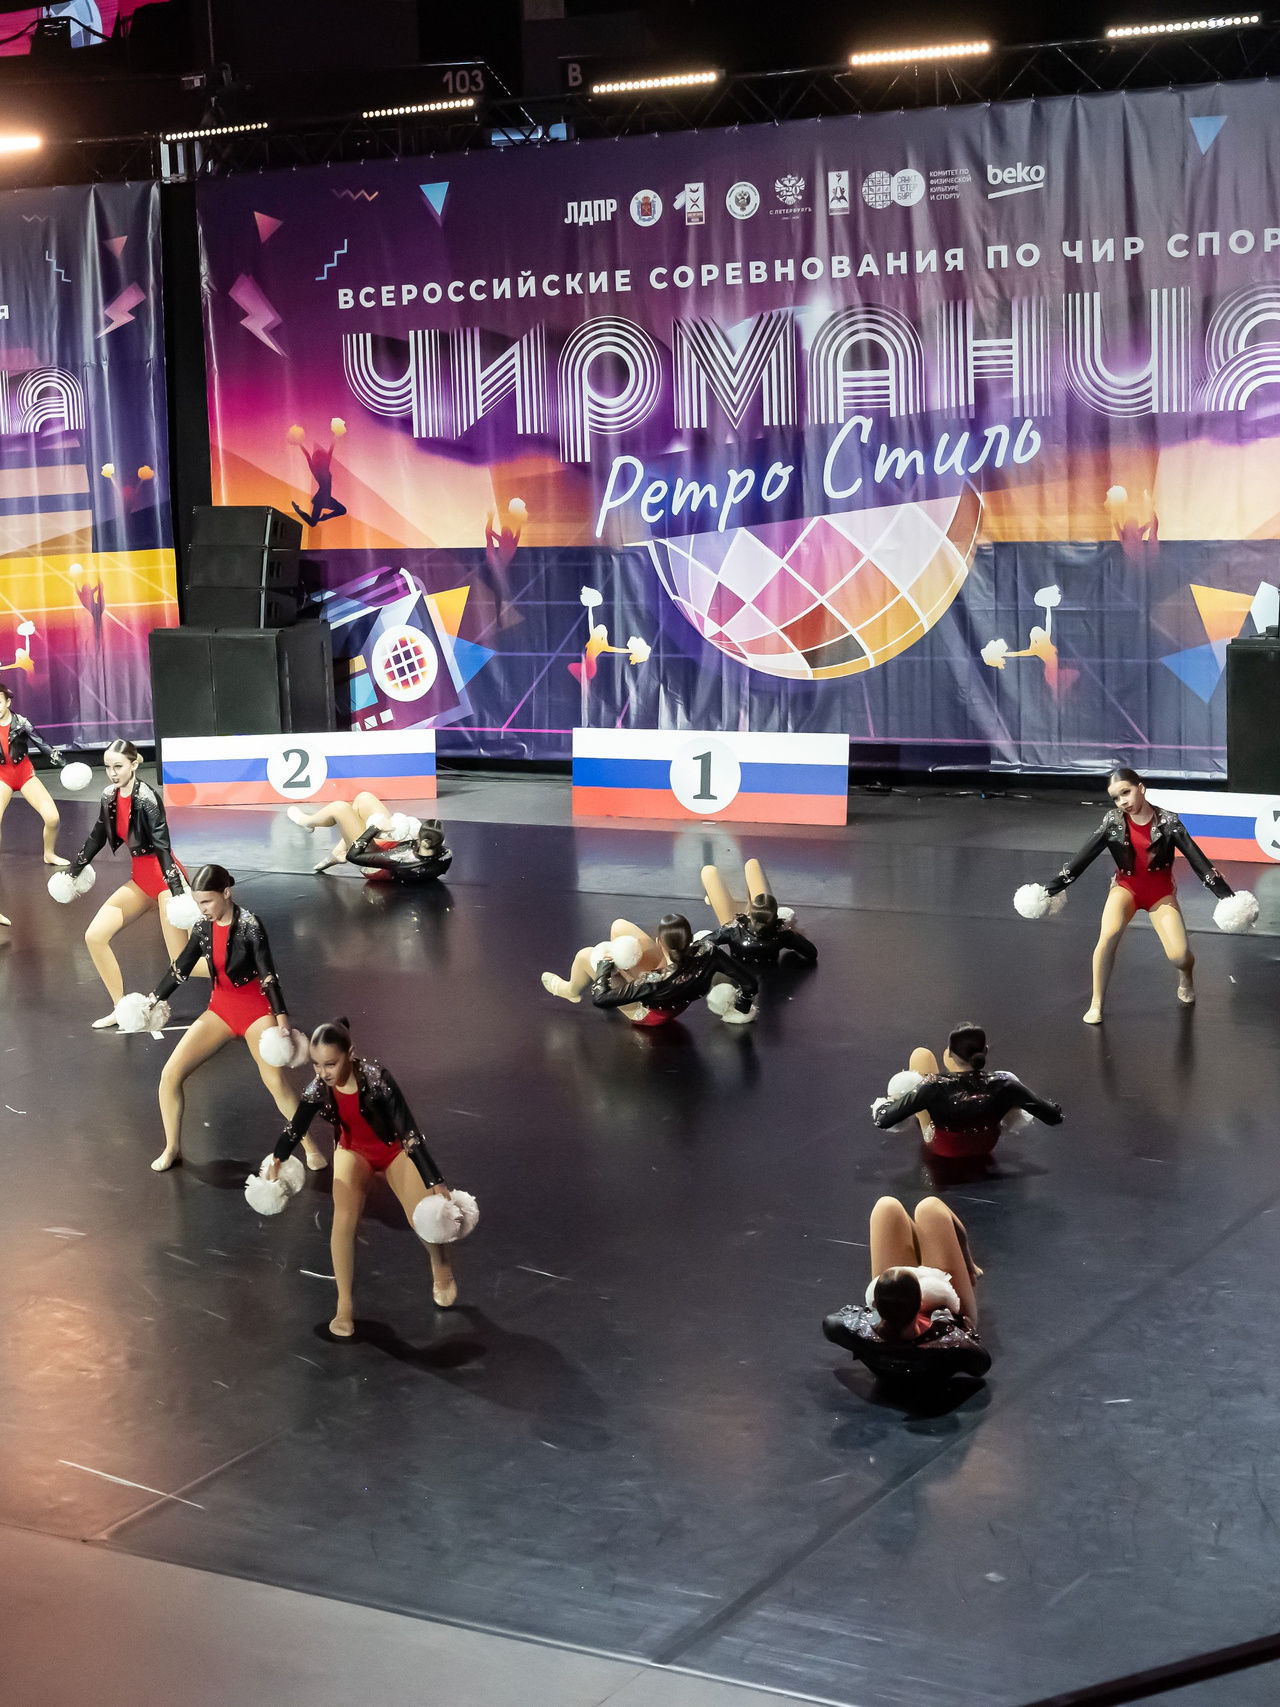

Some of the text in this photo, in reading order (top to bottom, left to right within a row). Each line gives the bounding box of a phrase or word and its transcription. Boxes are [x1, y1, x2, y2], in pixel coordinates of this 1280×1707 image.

[442, 69, 484, 94] 103
[897, 175, 918, 184] САНКТ
[929, 169, 958, 178] КОМИТЕТ
[929, 175, 972, 185] ФИЗИЧЕСКОЙ
[987, 162, 1045, 185] beko
[897, 183, 918, 192] ПЕТЕР
[929, 185, 959, 193] КУЛЬТУРЕ
[897, 192, 913, 201] БУРГ
[936, 193, 961, 201] СПОРТУ
[564, 198, 618, 227] ЛДПР
[337, 266, 633, 310] ВСЕРОССИЙСКИЕ
[649, 246, 966, 290] СОРЕВНОВАНИЯ
[986, 243, 1041, 268] ПО
[1061, 236, 1144, 263] ЧИР
[595, 415, 1042, 538] Ретро Стиль
[281, 749, 312, 788] 2
[690, 751, 717, 801] 1
